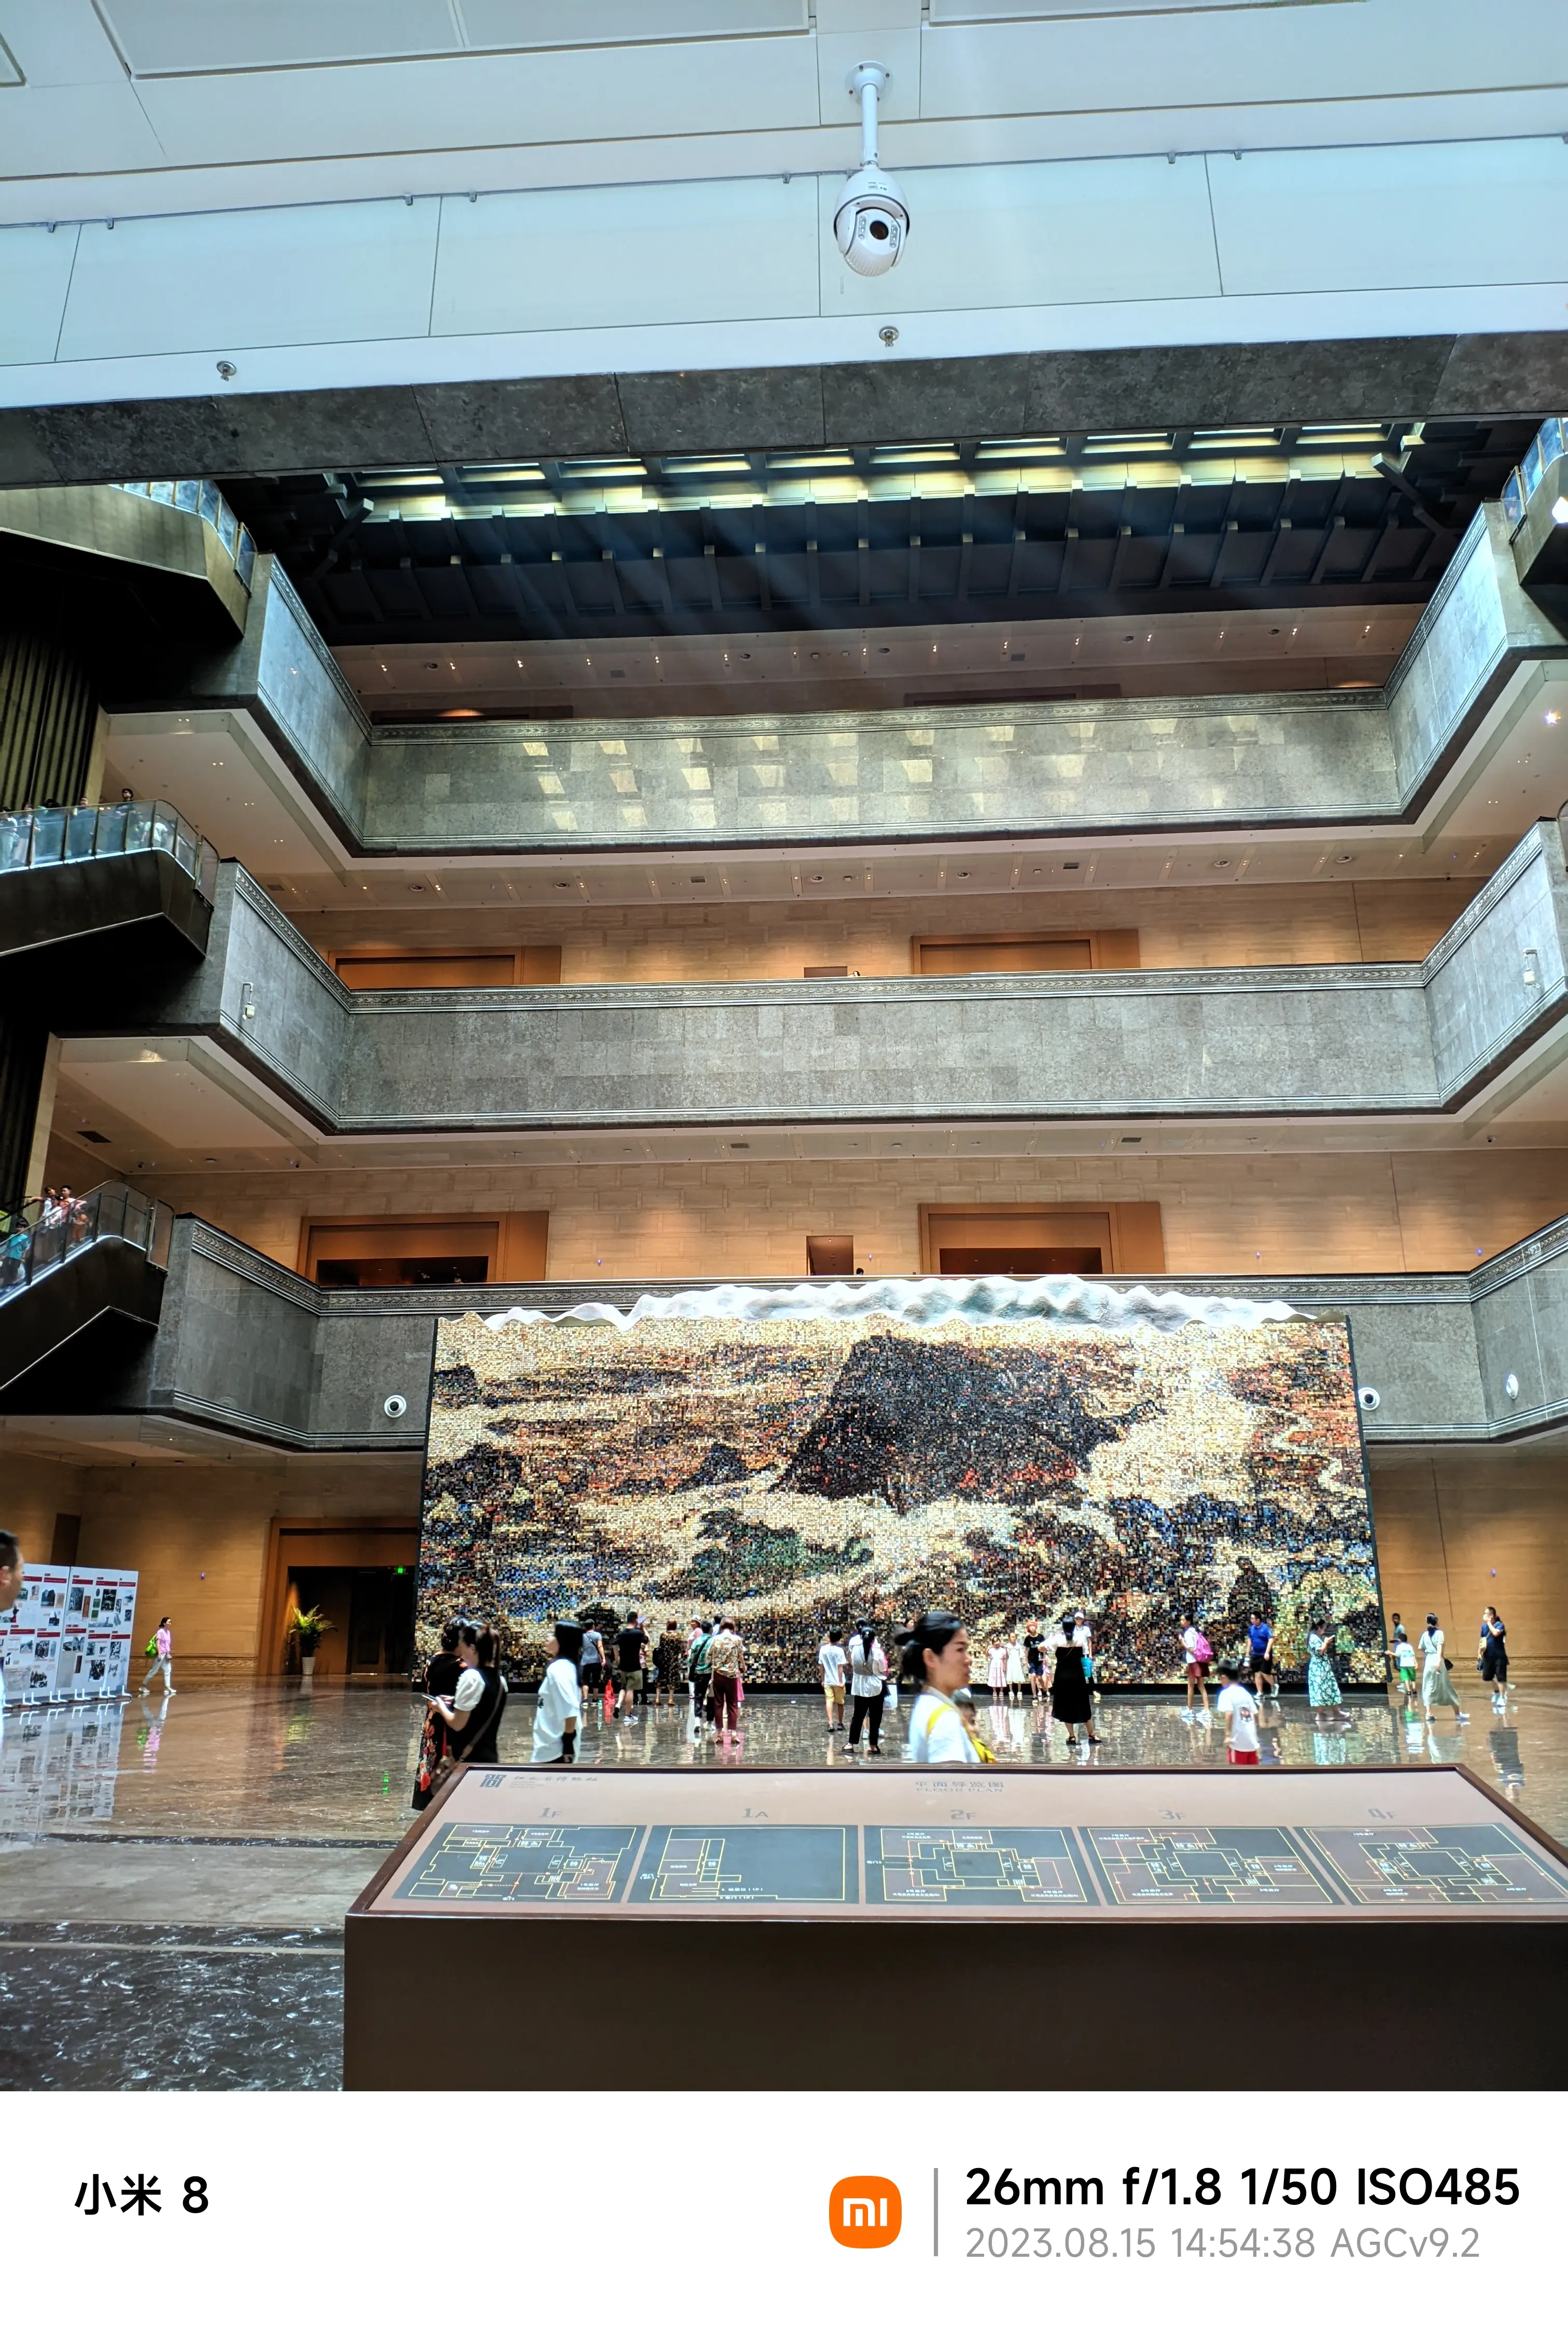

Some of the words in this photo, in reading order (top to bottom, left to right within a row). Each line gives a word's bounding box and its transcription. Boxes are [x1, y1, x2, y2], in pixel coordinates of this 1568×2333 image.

[539, 1807, 563, 1818] 1F
[742, 1808, 769, 1818] 1A
[950, 1809, 976, 1820] 2F
[1158, 1810, 1186, 1820] 3F
[1367, 1809, 1397, 1819] 4F
